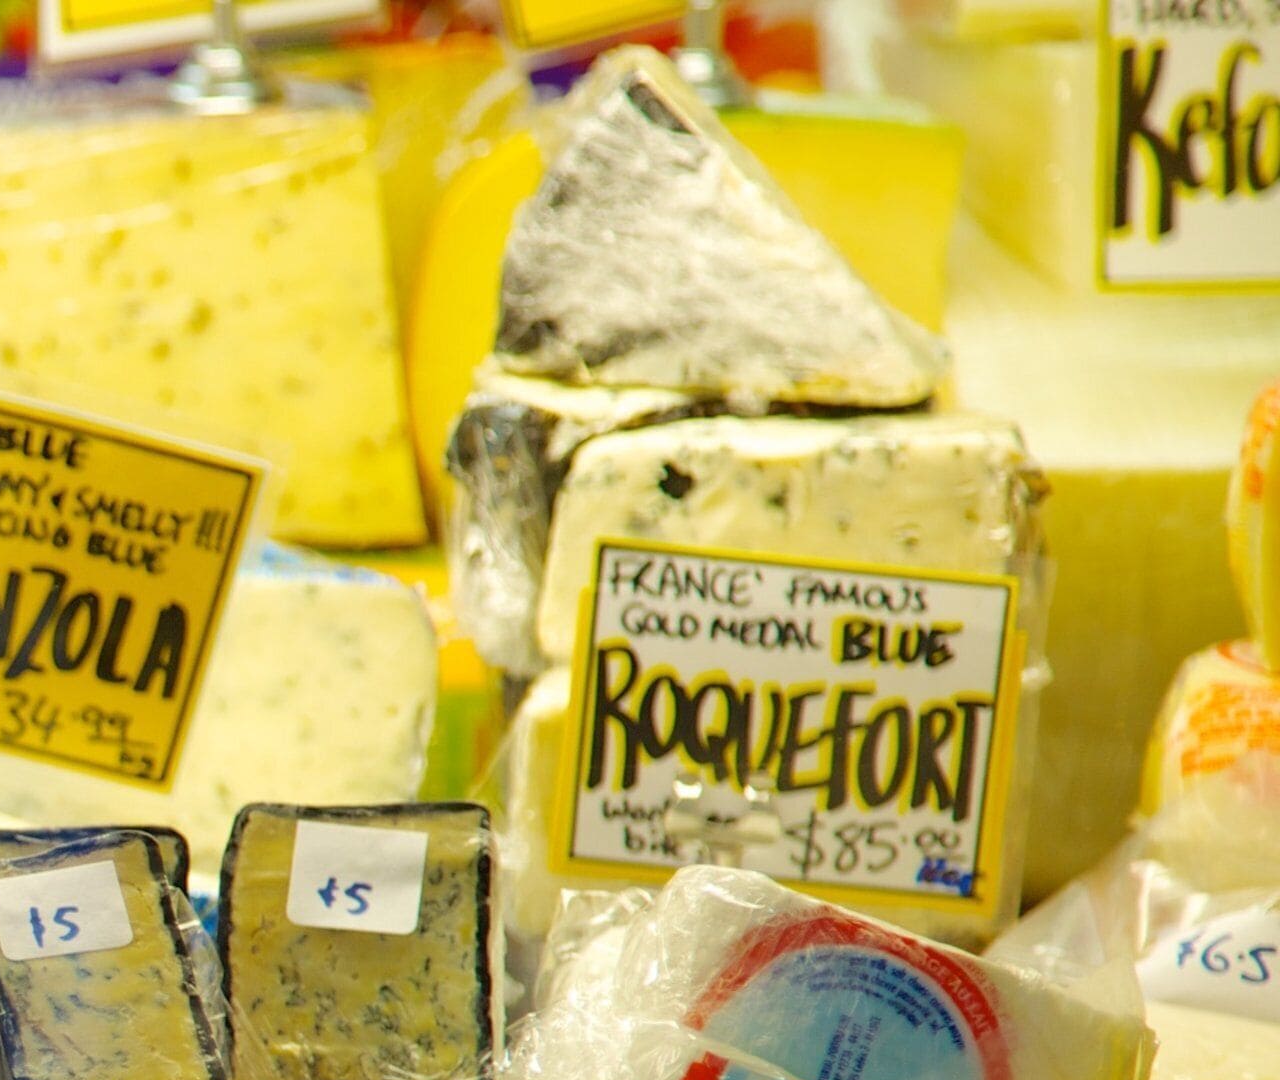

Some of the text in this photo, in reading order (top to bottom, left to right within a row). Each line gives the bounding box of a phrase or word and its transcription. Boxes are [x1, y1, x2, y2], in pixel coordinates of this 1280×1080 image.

[86, 529, 167, 577] BLUE
[785, 573, 929, 614] FAMOUS
[620, 601, 962, 668] GOLD MEDAL BLUE
[587, 638, 996, 824] ROQUEFORT
